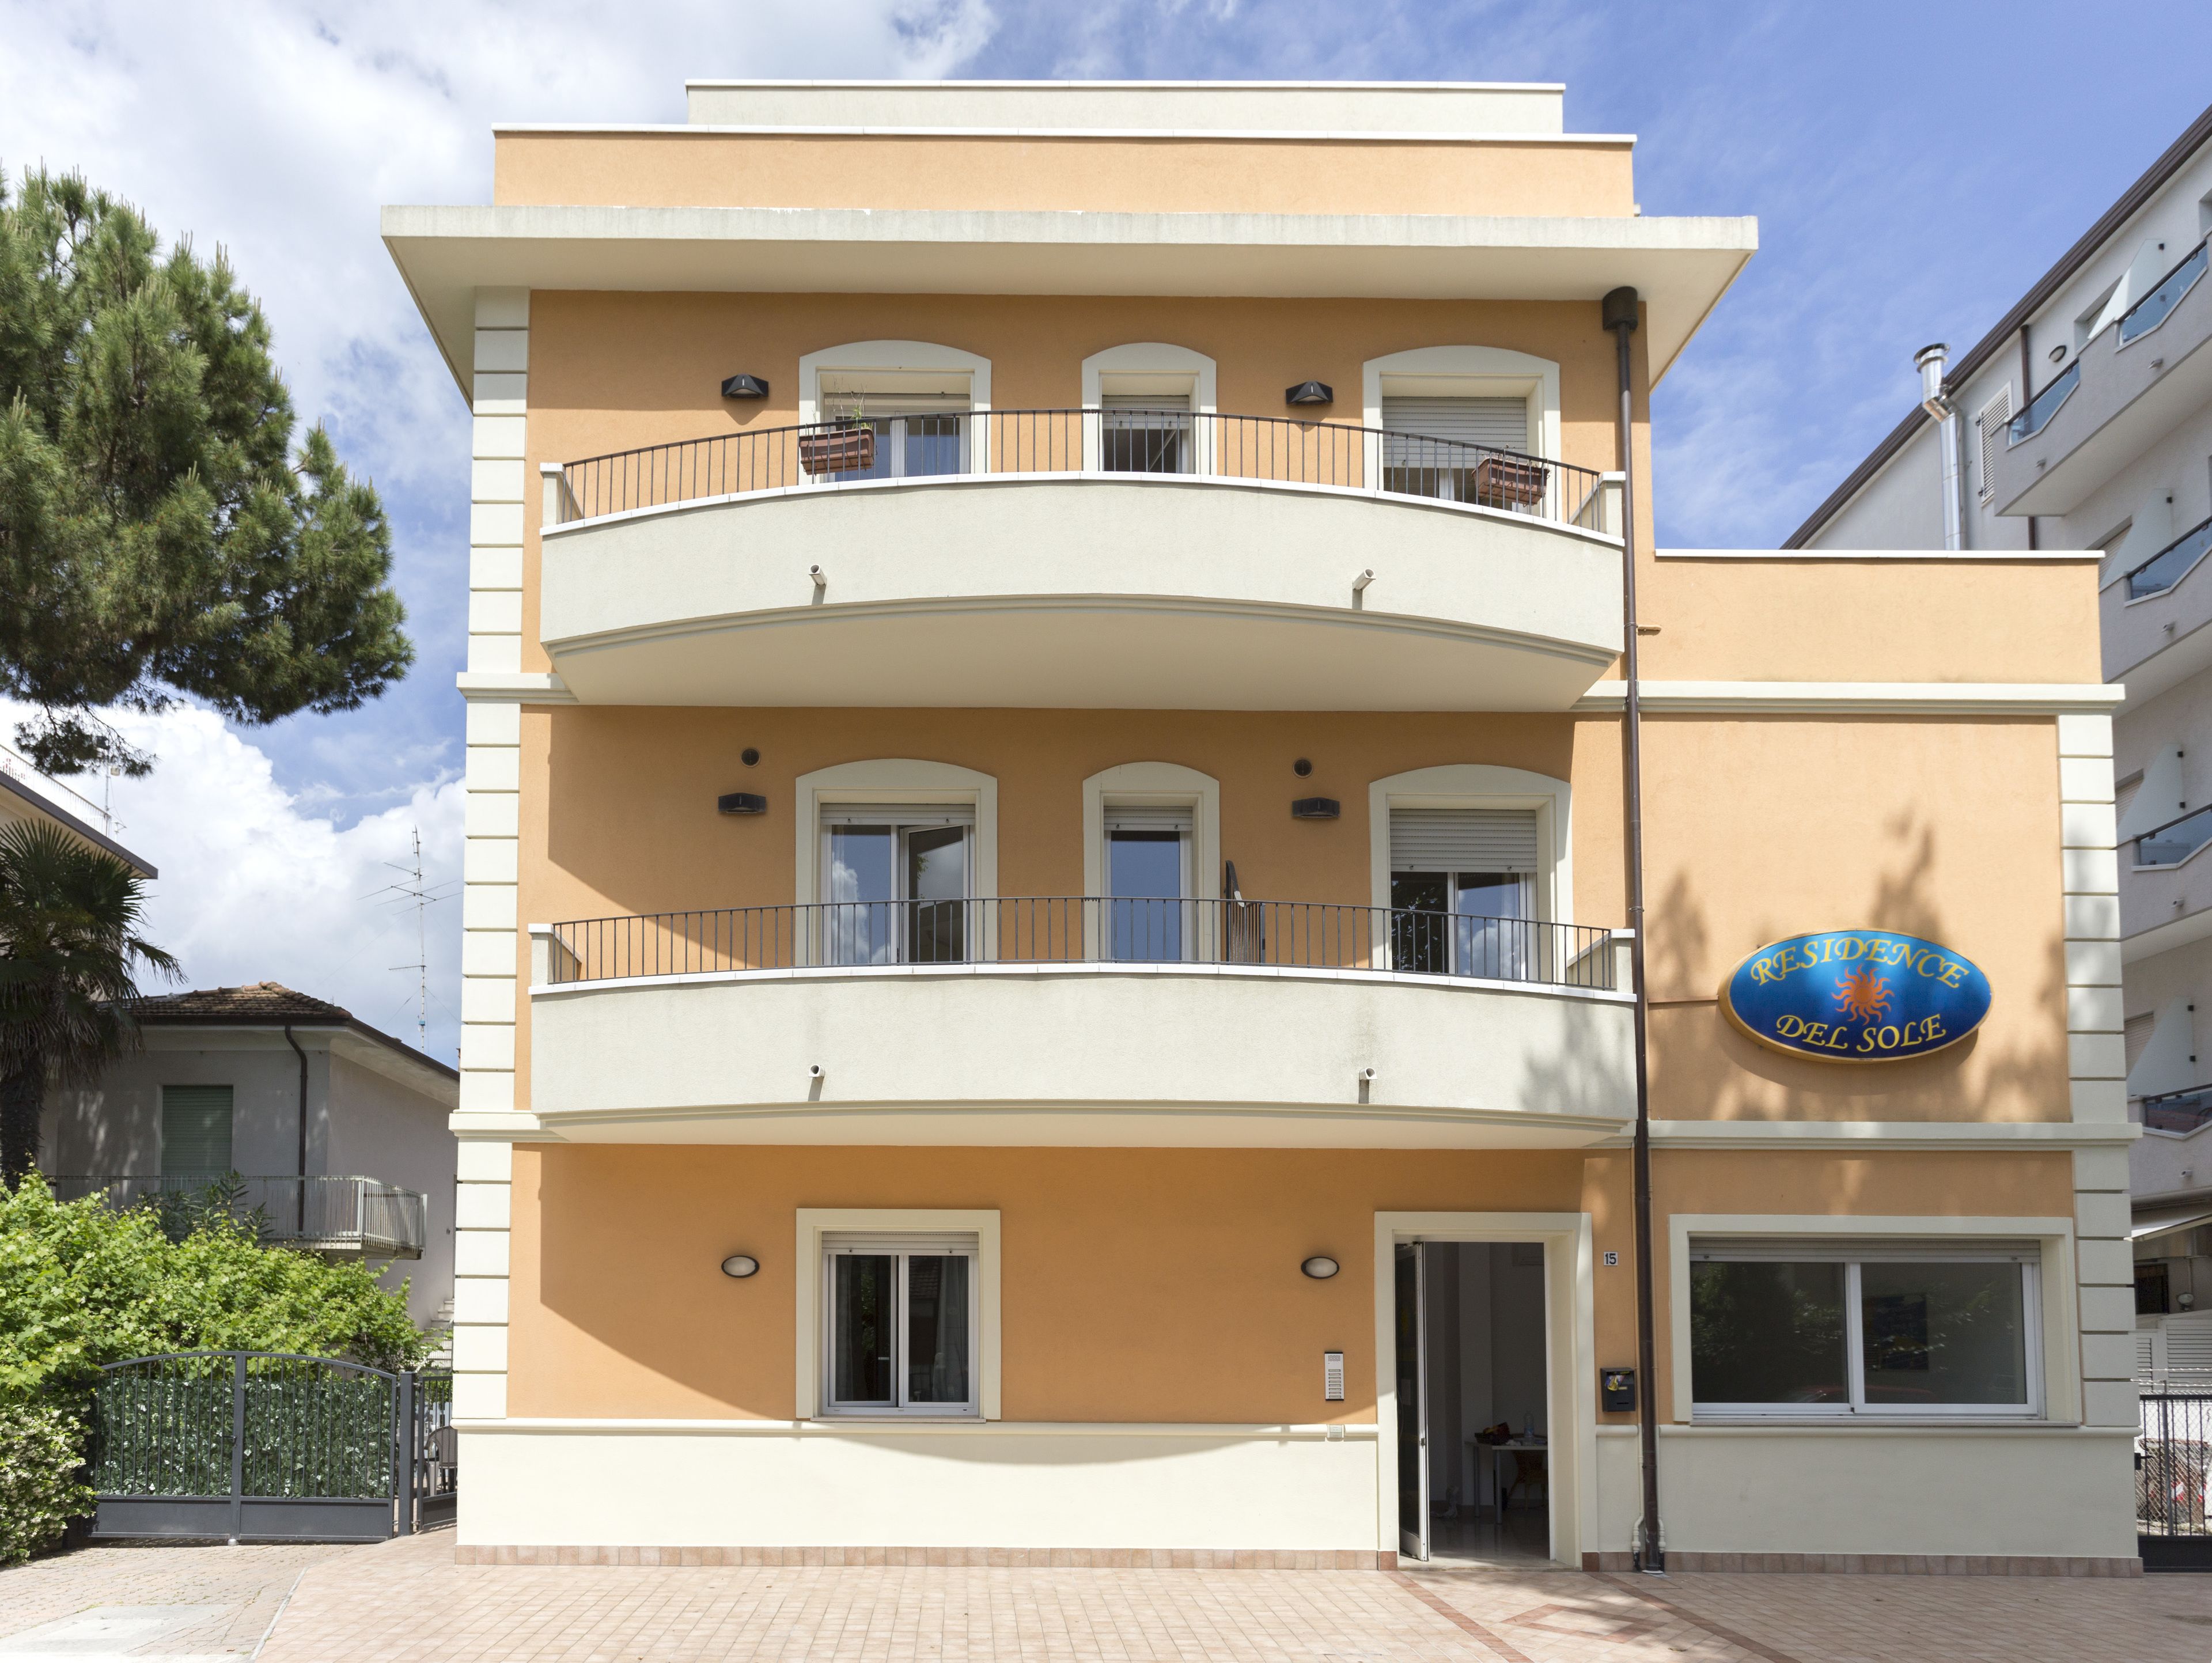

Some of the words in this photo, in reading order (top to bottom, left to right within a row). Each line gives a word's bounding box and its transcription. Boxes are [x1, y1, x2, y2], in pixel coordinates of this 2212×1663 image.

[1751, 937, 1969, 988] RESIDENCE
[1776, 1014, 1848, 1050] DEL
[1856, 1014, 1946, 1052] SOLE
[1605, 1253, 1616, 1265] 15
